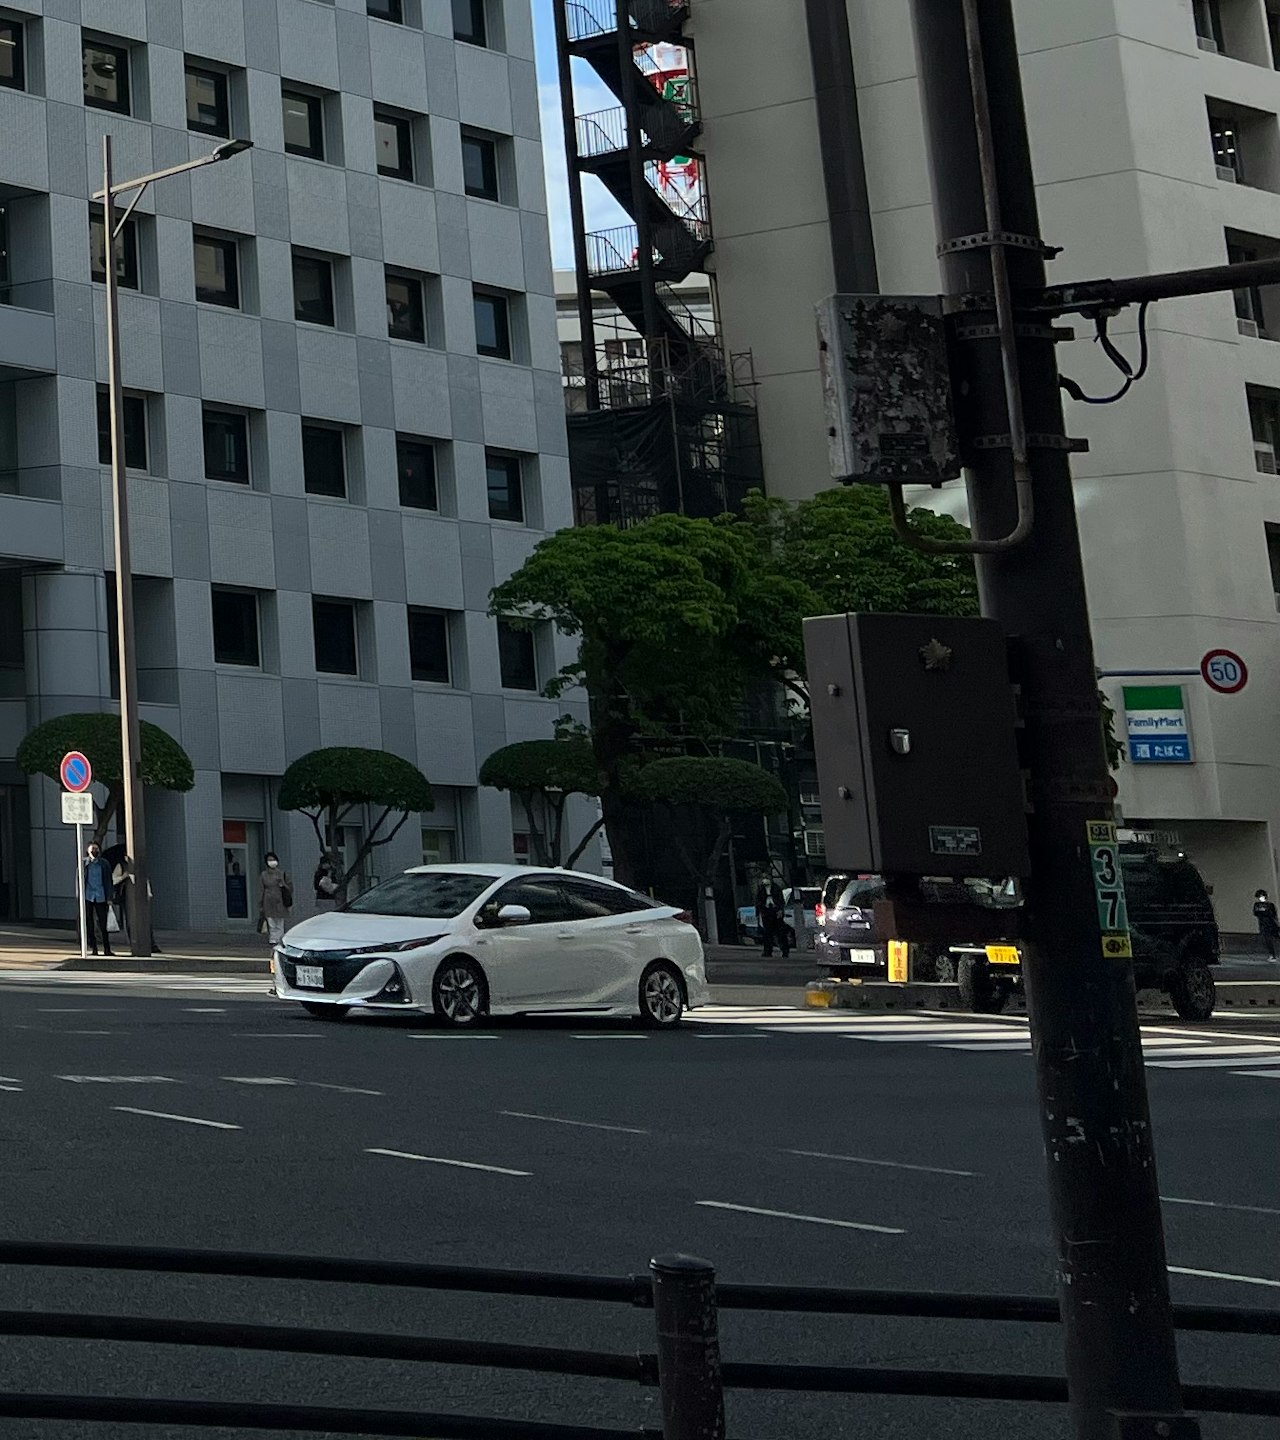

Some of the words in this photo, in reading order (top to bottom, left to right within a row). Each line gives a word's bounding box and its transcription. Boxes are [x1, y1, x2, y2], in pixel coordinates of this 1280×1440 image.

[1210, 662, 1238, 683] 50
[1127, 717, 1184, 729] FamilyMart
[1154, 745, 1185, 757] たばこ
